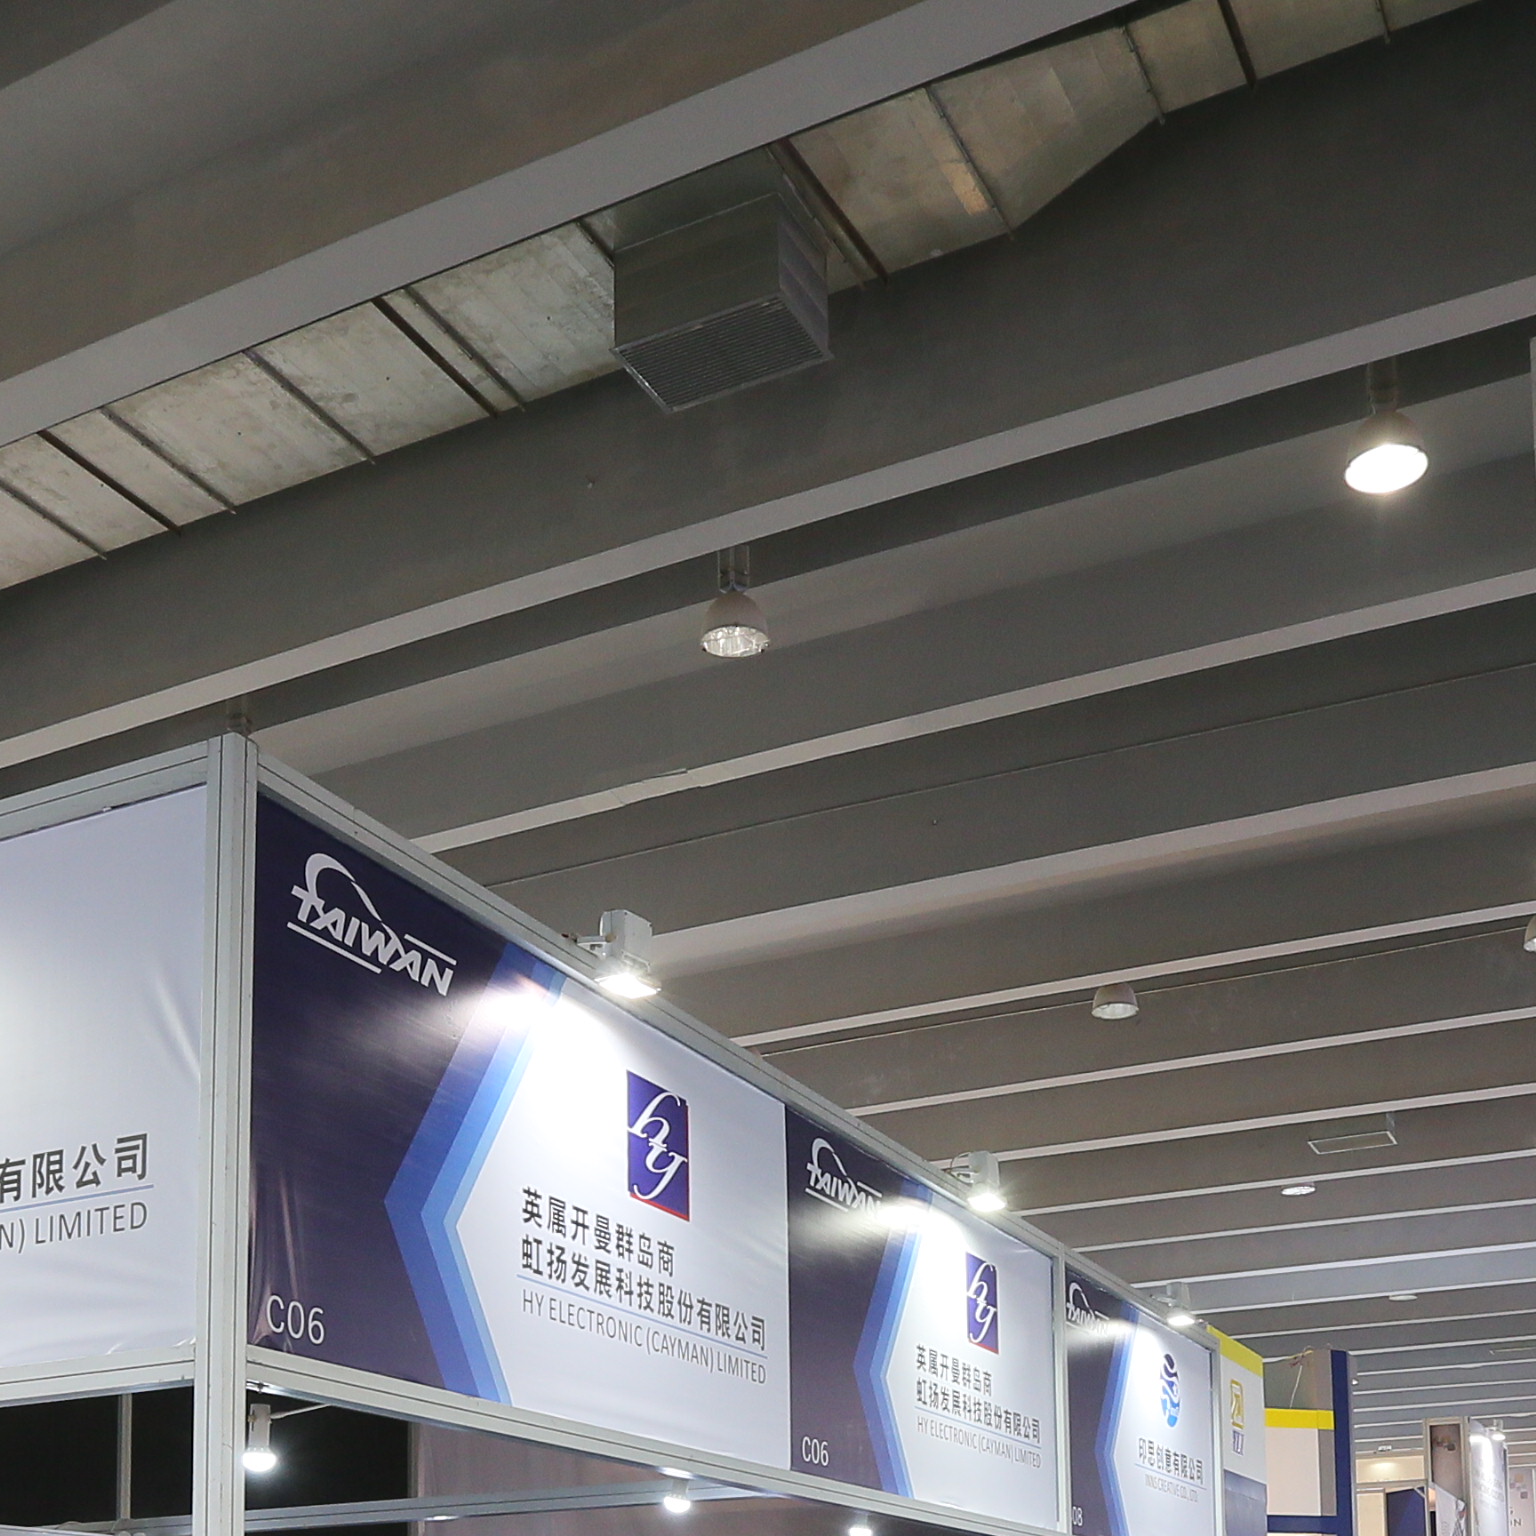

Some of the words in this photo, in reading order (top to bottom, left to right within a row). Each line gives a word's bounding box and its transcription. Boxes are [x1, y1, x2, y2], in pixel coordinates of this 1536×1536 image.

[287, 851, 456, 996] TAIWAN
[805, 1137, 882, 1220] TAIWAN
[33, 1200, 148, 1246] LIMITED
[521, 1186, 675, 1278] 英属开曼群岛商
[267, 1295, 326, 1346] C06
[521, 1234, 766, 1351] 虹扬发展科技股份有限公司
[523, 1288, 545, 1317] HY
[549, 1297, 643, 1348] ELECTRONIC
[646, 1327, 714, 1373] (CAYMAN)
[717, 1351, 767, 1385] LIMITED
[915, 1344, 993, 1398] 英属开曼群岛商
[916, 1376, 1041, 1445] 虹扬发展科技股份有限公司
[801, 1435, 830, 1467] C06
[917, 1416, 929, 1435] HY
[930, 1419, 977, 1450] ELECTRONIC
[978, 1434, 1014, 1464] (CAYMAN)
[1015, 1448, 1042, 1469] LIMITED
[1072, 1505, 1084, 1527] 08
